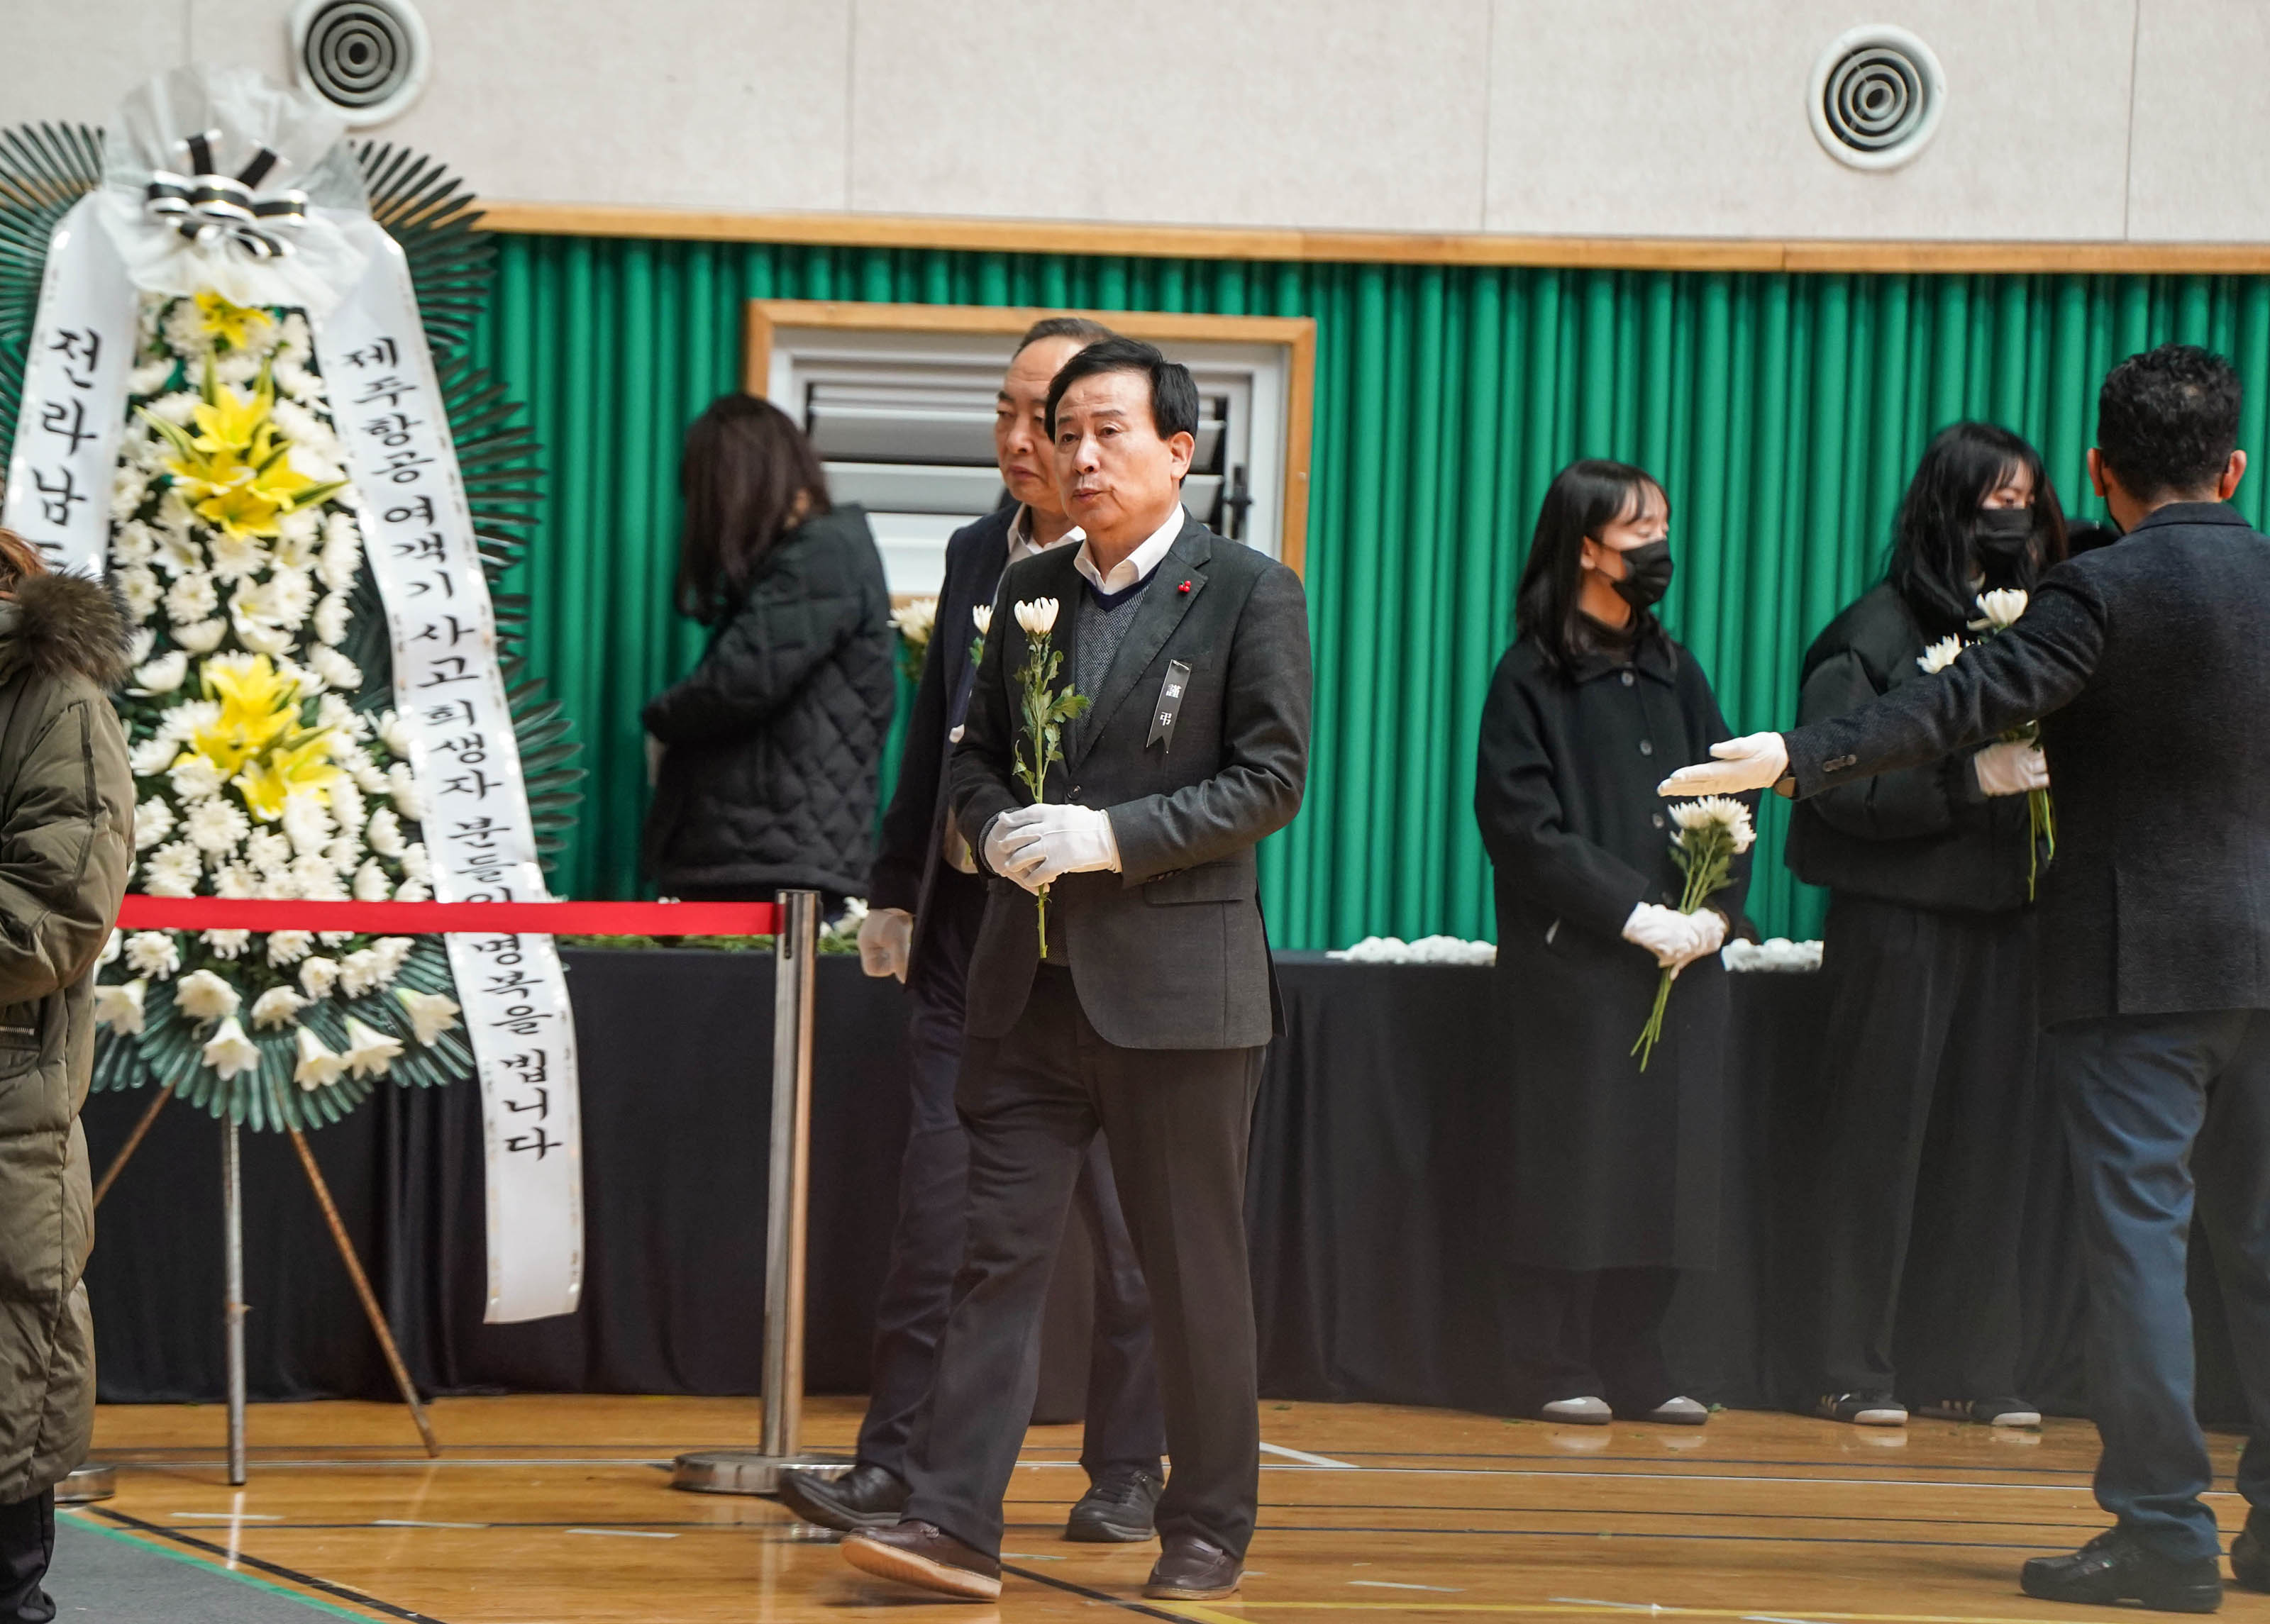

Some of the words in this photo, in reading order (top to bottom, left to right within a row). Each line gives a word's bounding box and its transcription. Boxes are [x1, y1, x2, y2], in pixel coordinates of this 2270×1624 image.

[341, 336, 434, 484] 제주항공
[384, 495, 453, 598] 여객기
[411, 613, 480, 688] 사고
[421, 699, 503, 800] 희생자
[470, 933, 553, 1035] 명복을
[499, 1047, 563, 1161] 빕니다
